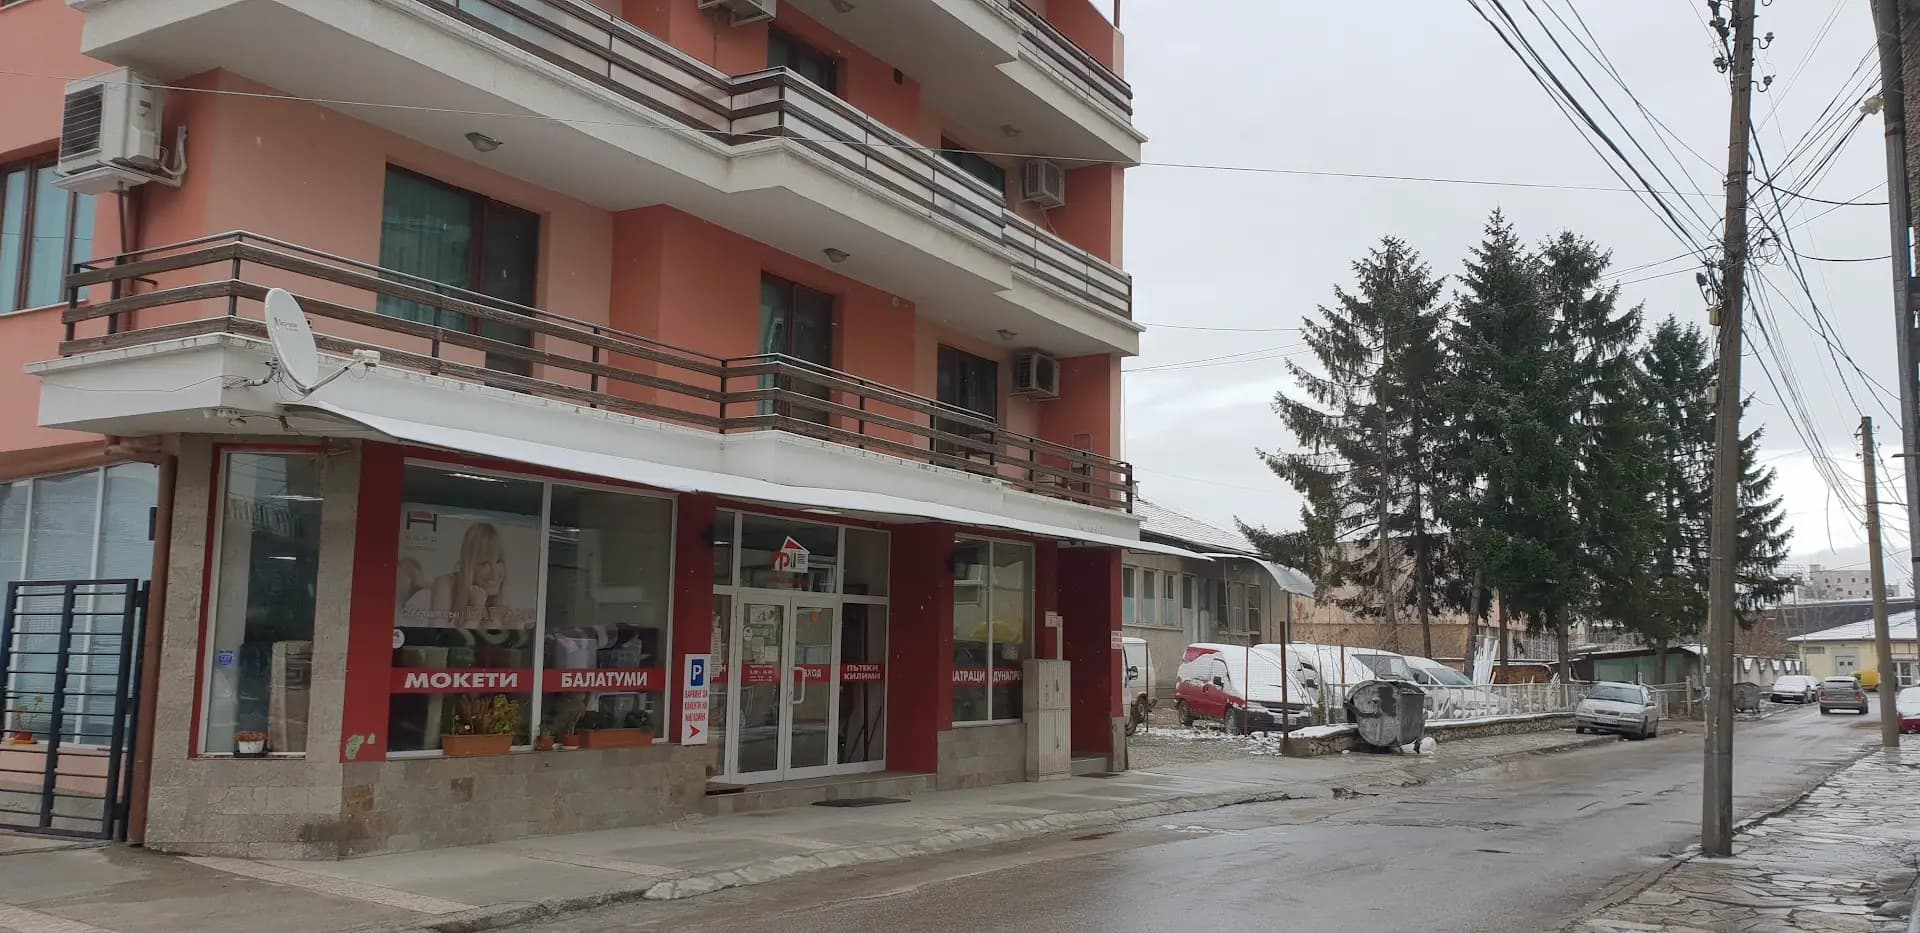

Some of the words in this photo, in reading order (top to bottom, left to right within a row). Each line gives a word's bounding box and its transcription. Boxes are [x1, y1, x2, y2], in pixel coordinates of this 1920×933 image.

[404, 672, 518, 689] МОКЕТИ
[561, 671, 648, 688] БАЛАТУМИ
[692, 665, 702, 680] P
